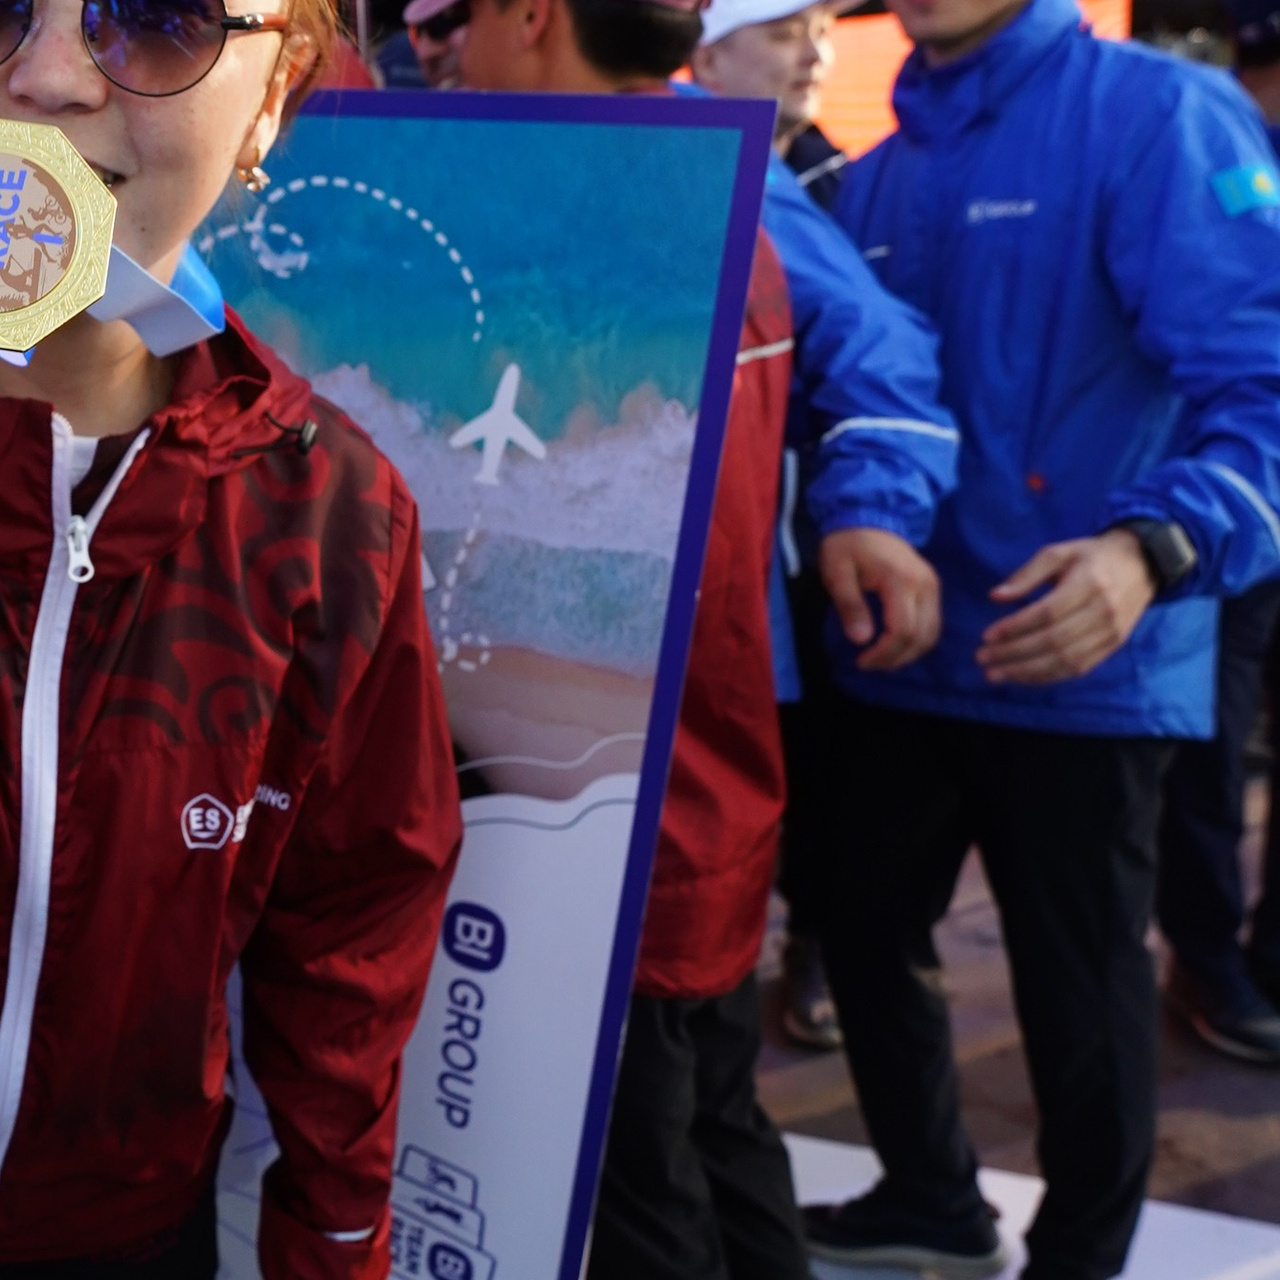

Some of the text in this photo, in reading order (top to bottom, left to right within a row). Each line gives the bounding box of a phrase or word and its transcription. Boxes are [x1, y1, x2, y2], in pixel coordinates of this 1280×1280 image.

[189, 807, 221, 831] ES
[434, 913, 496, 1131] BI GROUP
